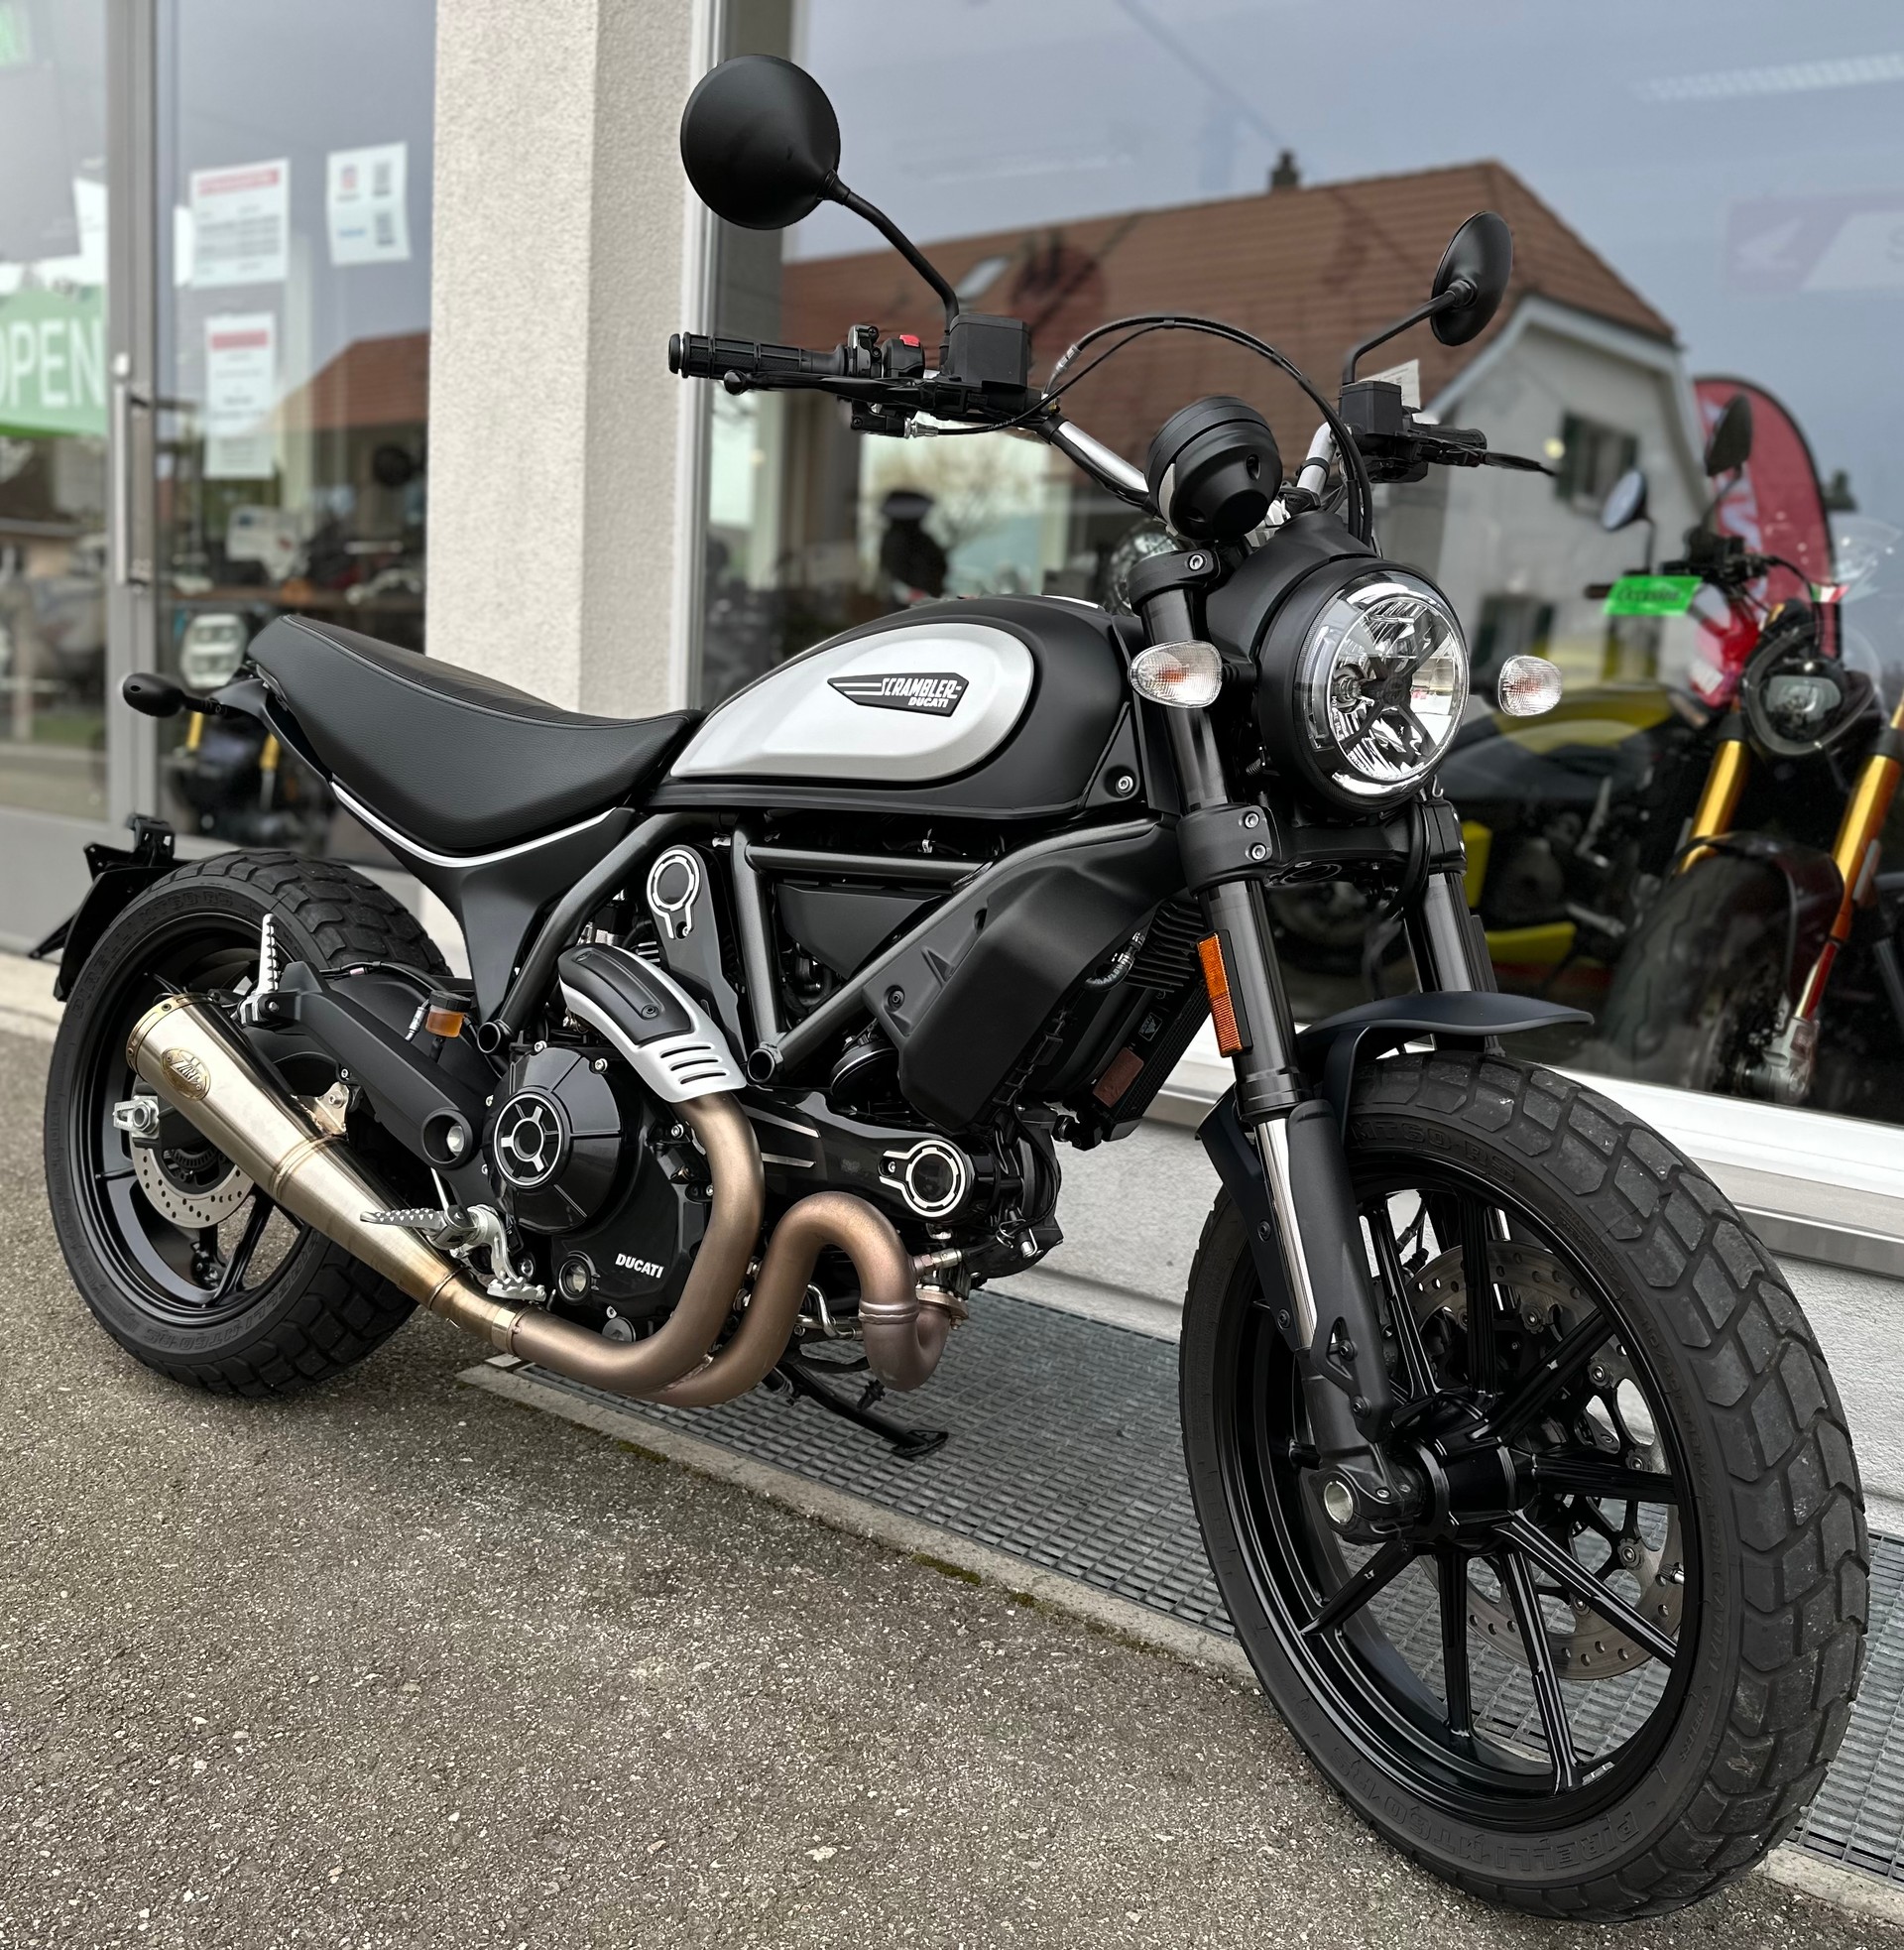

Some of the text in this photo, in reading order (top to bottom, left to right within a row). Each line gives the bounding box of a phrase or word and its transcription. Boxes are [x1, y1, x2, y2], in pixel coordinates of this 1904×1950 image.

[0, 318, 105, 408] PEN
[881, 677, 962, 699] SCRAMBLER
[907, 696, 949, 708] DUCATI
[1351, 1119, 1516, 1182] MT60 RS
[615, 1253, 664, 1279] DUCATI
[1384, 1797, 1488, 1865] MT60
[1494, 1810, 1640, 1873] PIRELLI
